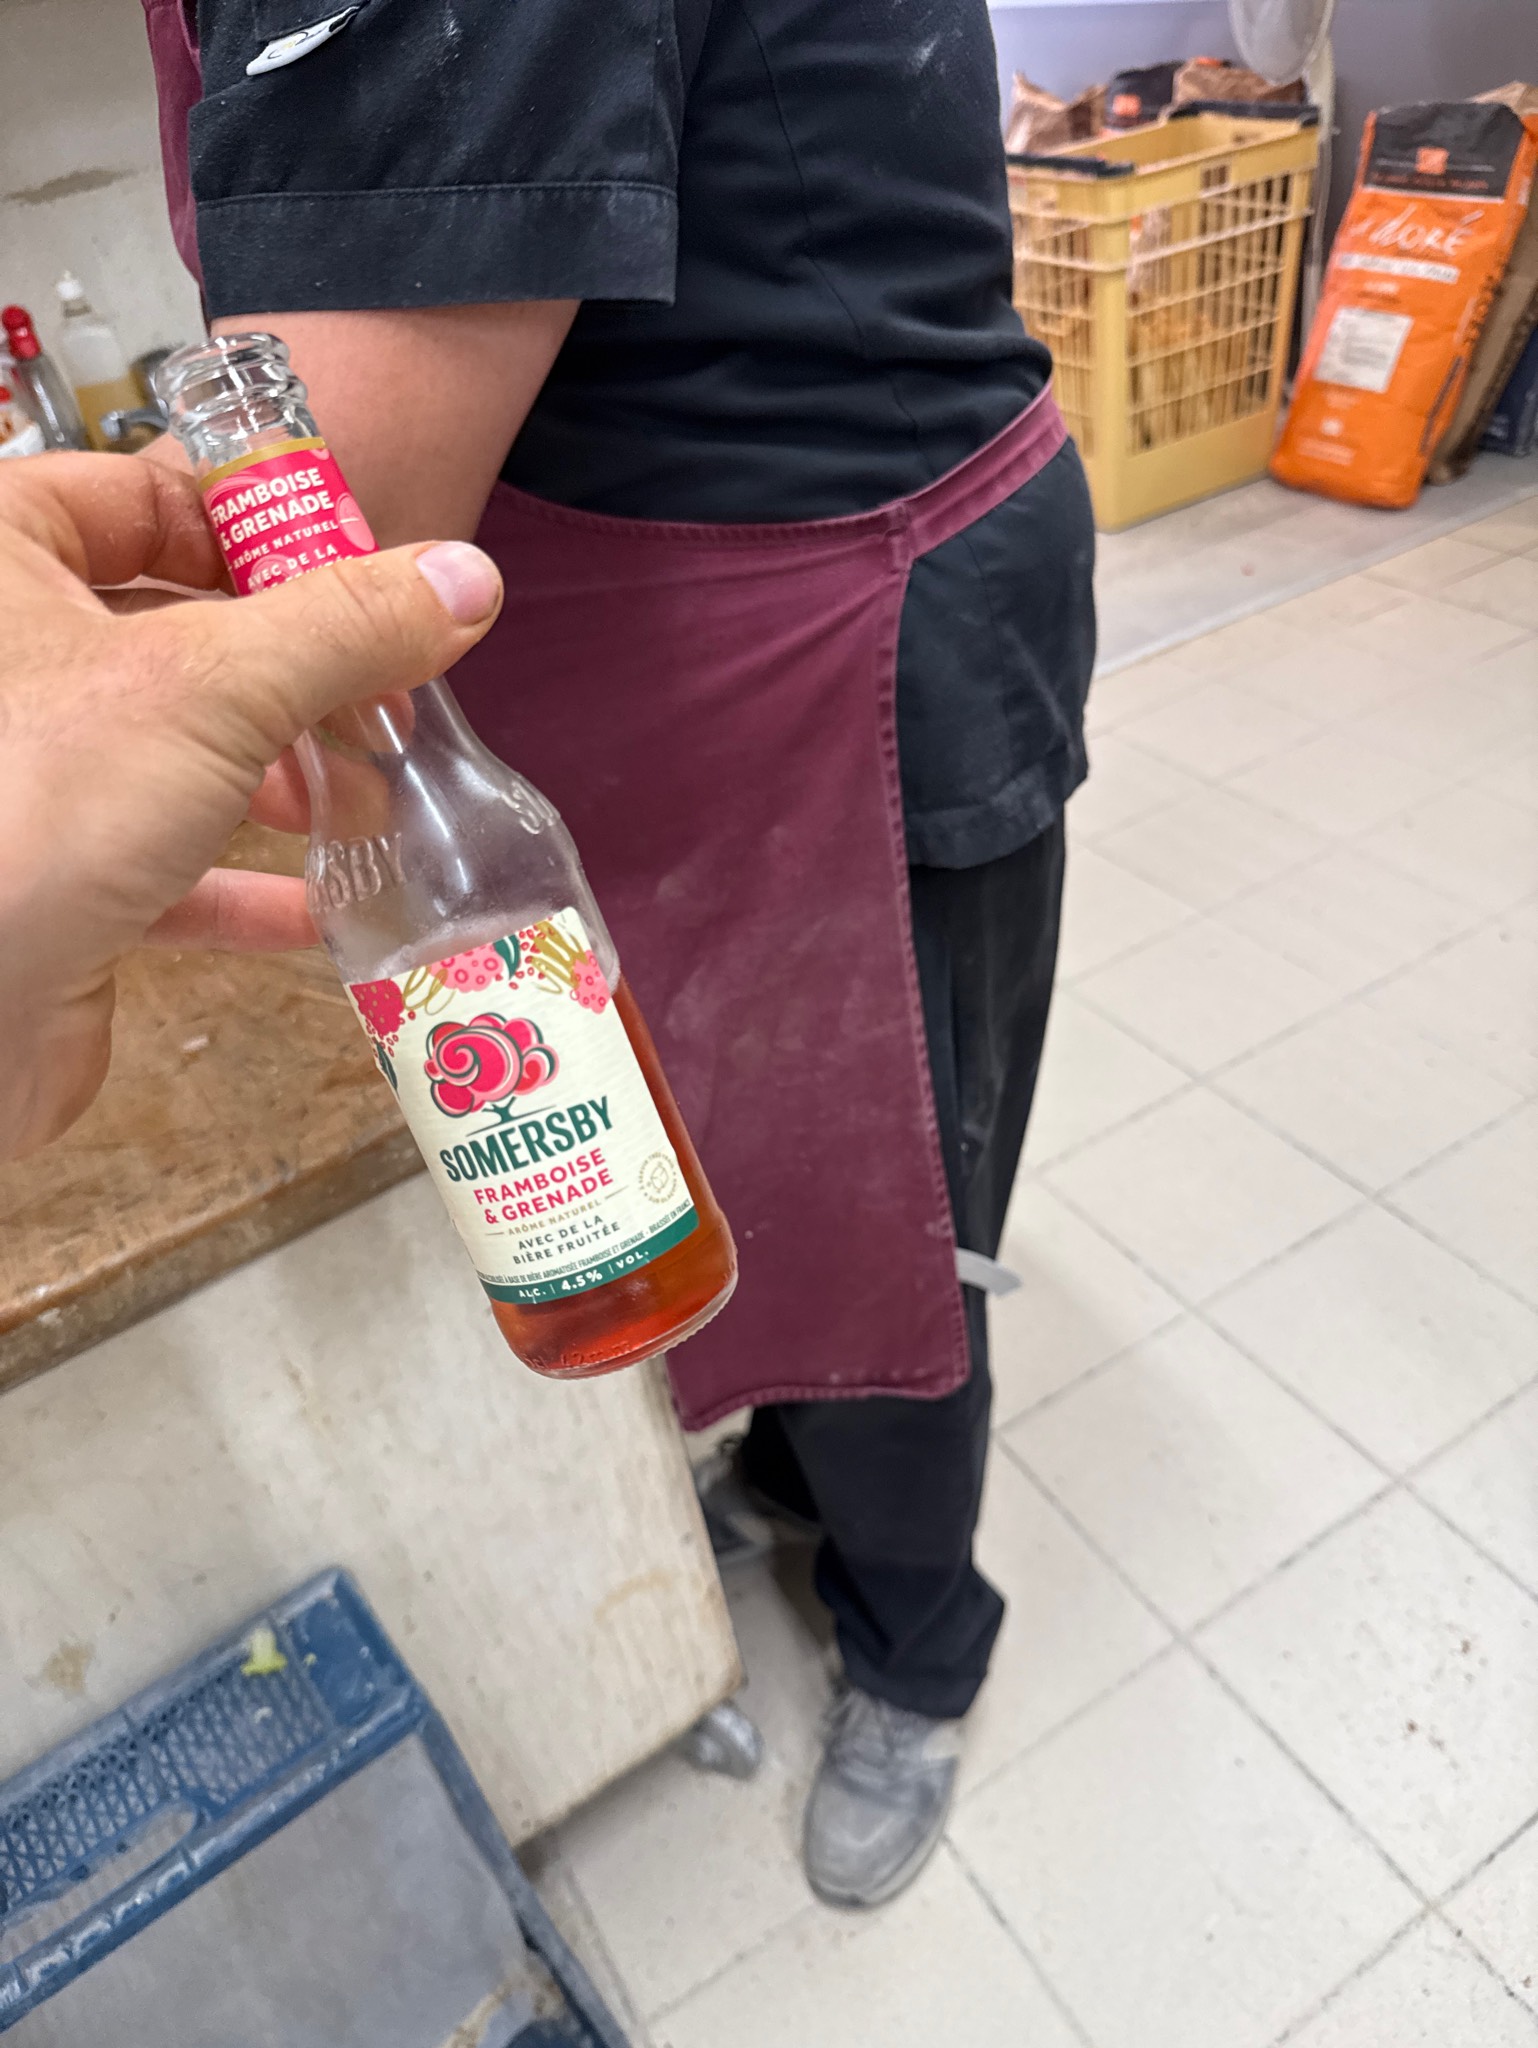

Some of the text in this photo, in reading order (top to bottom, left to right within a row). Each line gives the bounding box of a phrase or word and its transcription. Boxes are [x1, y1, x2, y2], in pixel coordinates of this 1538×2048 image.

[211, 467, 324, 528] FRAMBOISE
[220, 490, 334, 551] & GRENADE
[233, 519, 339, 570] ARÔME NATUREL
[247, 563, 282, 590] AVEC
[286, 552, 310, 570] DE
[314, 543, 338, 560] LA
[439, 1095, 613, 1182] SOMERSBY
[473, 1148, 606, 1205] FRAMBOISE
[484, 1167, 614, 1225] & GRENADE
[508, 1199, 602, 1236] ARÔME NATUREL
[513, 1221, 621, 1265] BIÈRE FRUITÉE
[519, 1214, 604, 1250] AVEC DE LA
[518, 1250, 650, 1298] ALC. 4.5% VOL.
